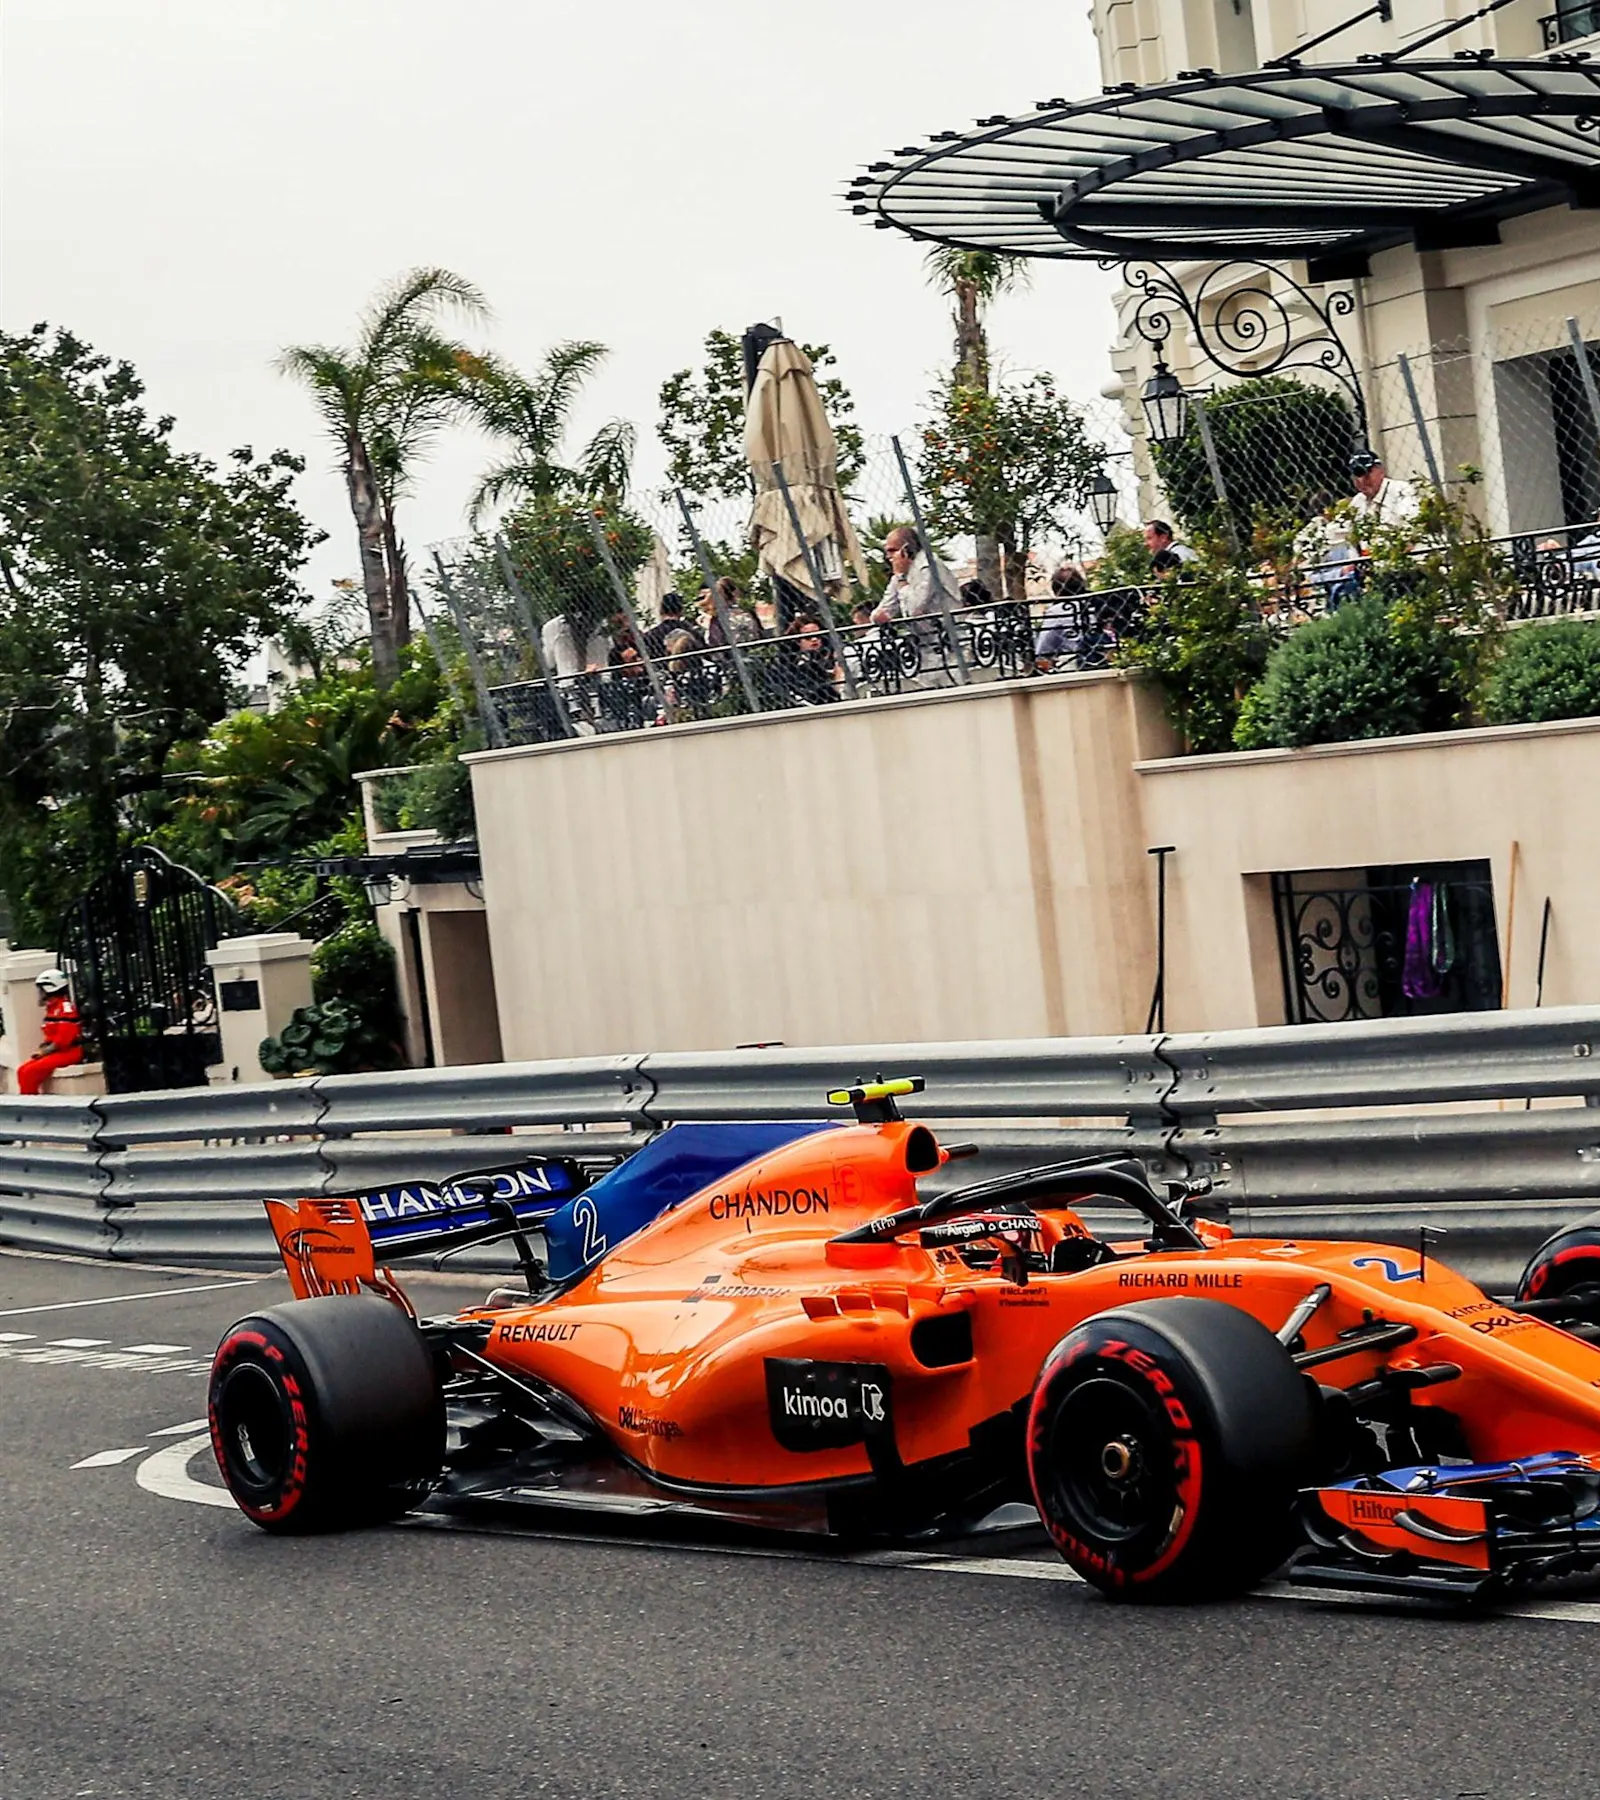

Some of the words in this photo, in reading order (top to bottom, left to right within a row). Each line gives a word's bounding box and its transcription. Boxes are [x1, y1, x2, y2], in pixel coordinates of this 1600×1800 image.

[361, 1166, 552, 1222] HANDON
[709, 1187, 829, 1220] CHANDON
[573, 1195, 607, 1266] 2
[947, 1222, 985, 1238] Airgain
[1119, 1273, 1189, 1288] RICHARD
[1194, 1273, 1243, 1288] MILLE
[1353, 1256, 1422, 1284] 2
[499, 1324, 582, 1343] RENAULT
[1096, 1340, 1193, 1430] ZERO
[264, 1344, 284, 1362] P
[281, 1373, 309, 1484] ZERO
[783, 1386, 849, 1419] kimoa
